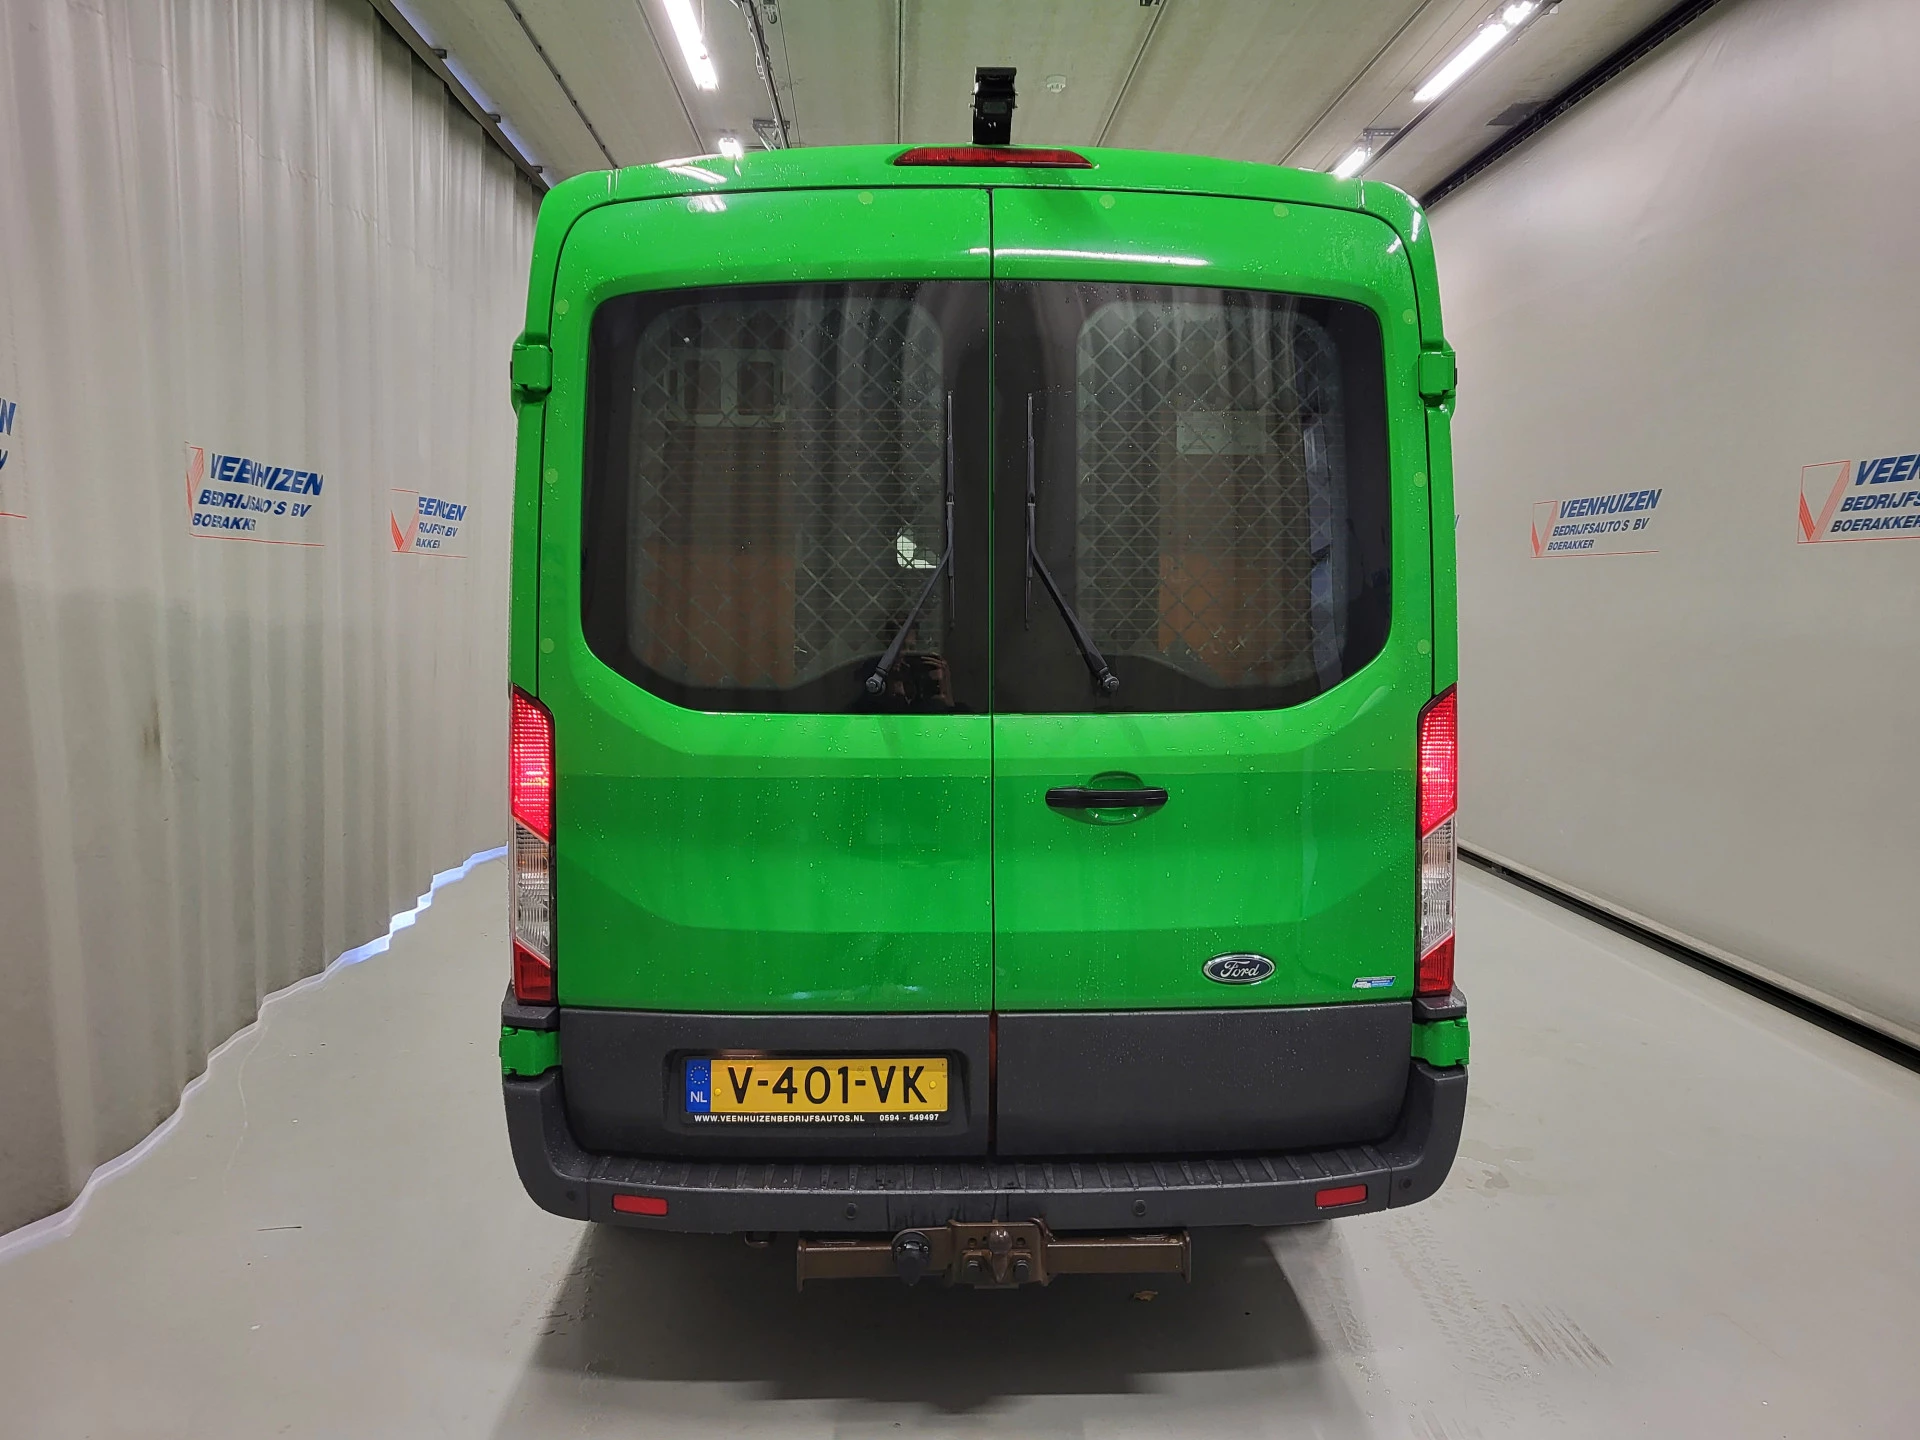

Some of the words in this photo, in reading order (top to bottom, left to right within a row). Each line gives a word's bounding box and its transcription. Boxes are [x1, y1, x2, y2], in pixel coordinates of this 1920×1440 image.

[291, 502, 312, 517] BV
[1559, 488, 1662, 518] VEENHUIZEN
[445, 525, 458, 537] BV
[1552, 519, 1630, 536] BEDRIJFSAUTO'S
[1633, 517, 1650, 531] BV
[1547, 539, 1595, 551] BOERAKKER
[1220, 960, 1260, 978] Ford
[727, 1065, 929, 1105] V-401-VK
[690, 1091, 708, 1103] NL
[694, 1114, 866, 1123] WWW.VEENHUIZENBEDRIJFSAUTOS.NL
[879, 1113, 900, 1122] 0594
[908, 1113, 940, 1121] 549497
